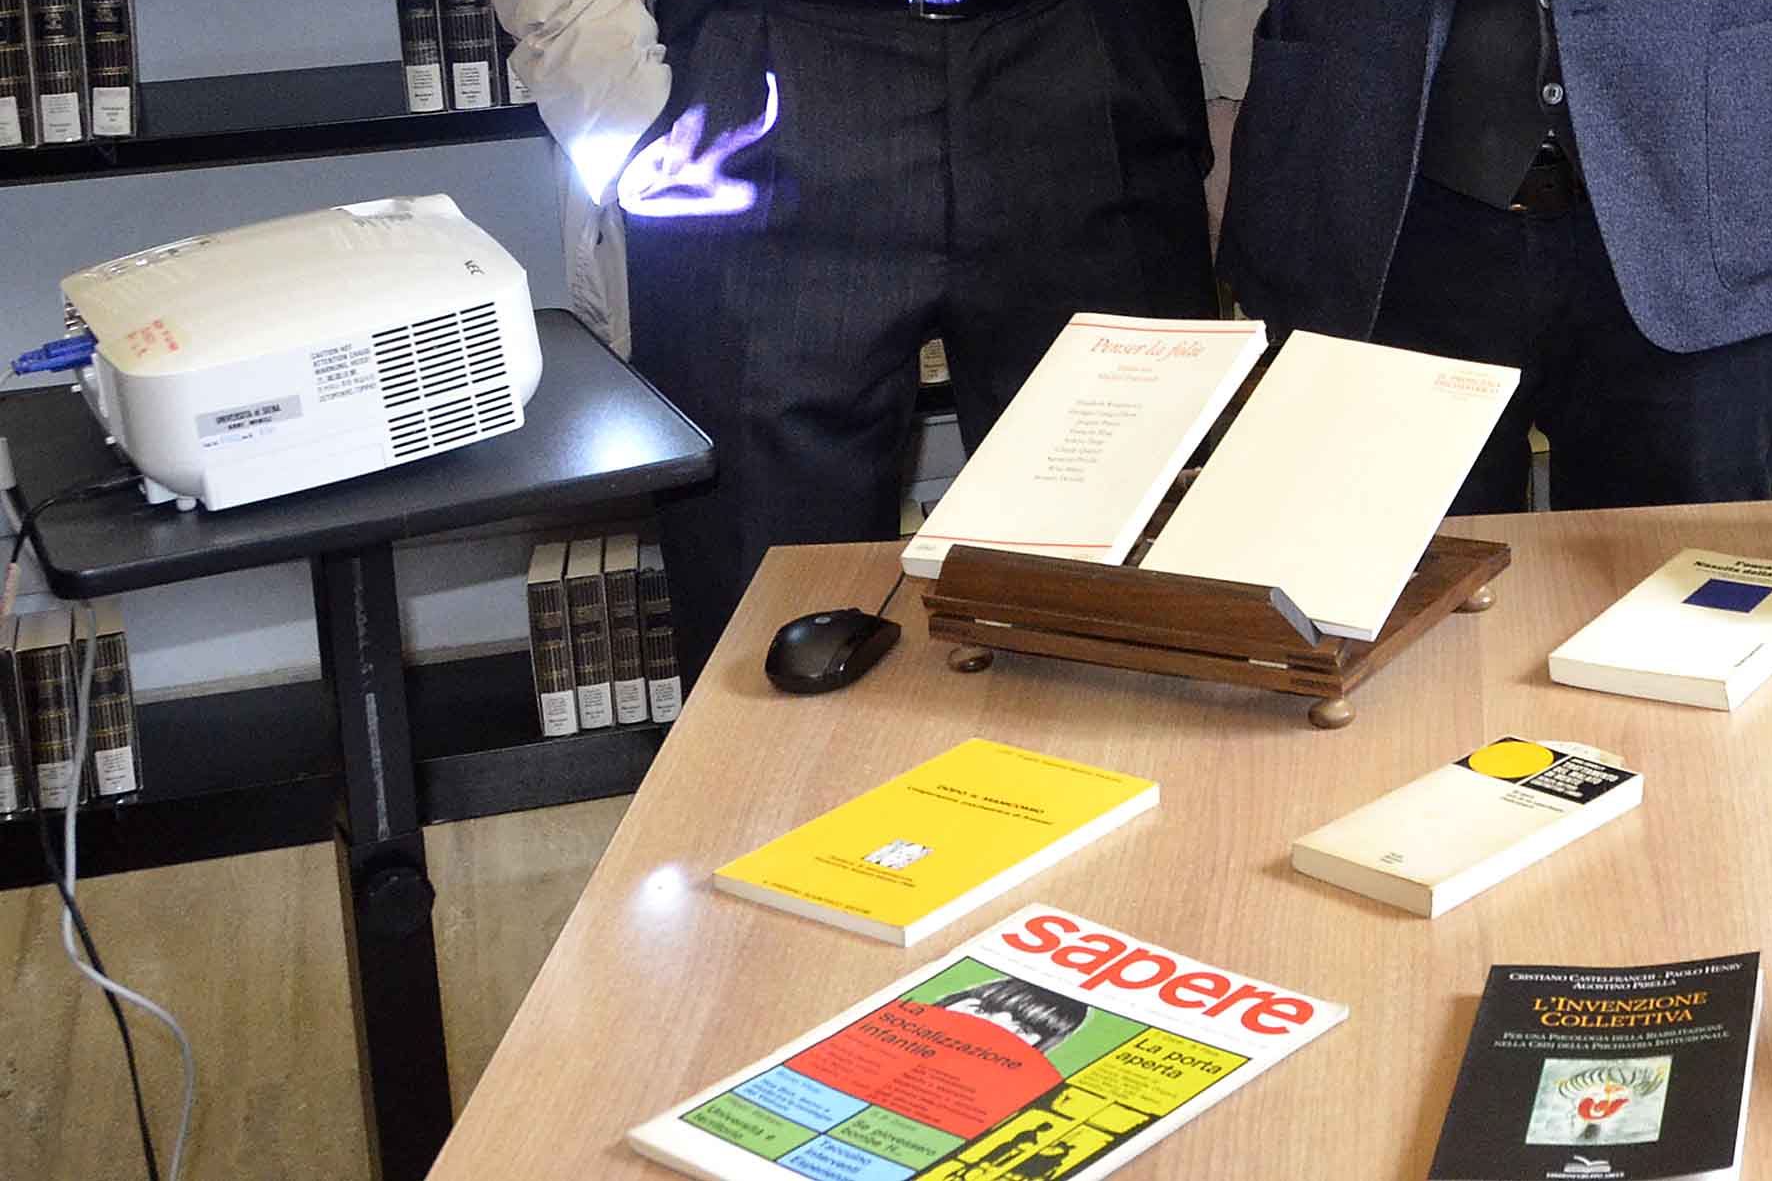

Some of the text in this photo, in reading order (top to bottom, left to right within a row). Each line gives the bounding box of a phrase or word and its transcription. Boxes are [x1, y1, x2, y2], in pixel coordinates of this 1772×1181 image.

[1089, 337, 1147, 355] Penser
[1742, 568, 1772, 577] della
[1001, 915, 1315, 1036] sapere
[1509, 962, 1743, 984] CRISTIANO CASTELFRANCHI PAOLO HENRY
[1572, 980, 1631, 990] AGOSTINO
[898, 997, 925, 1016] La
[1533, 990, 1709, 1012] L'INVENZIONE
[1539, 1009, 1694, 1028] COLLETTIVA
[858, 1022, 937, 1059] infantile
[879, 1010, 1023, 1070] socializzazione
[1115, 1050, 1183, 1080] aperta
[1133, 1037, 1223, 1076] La porta
